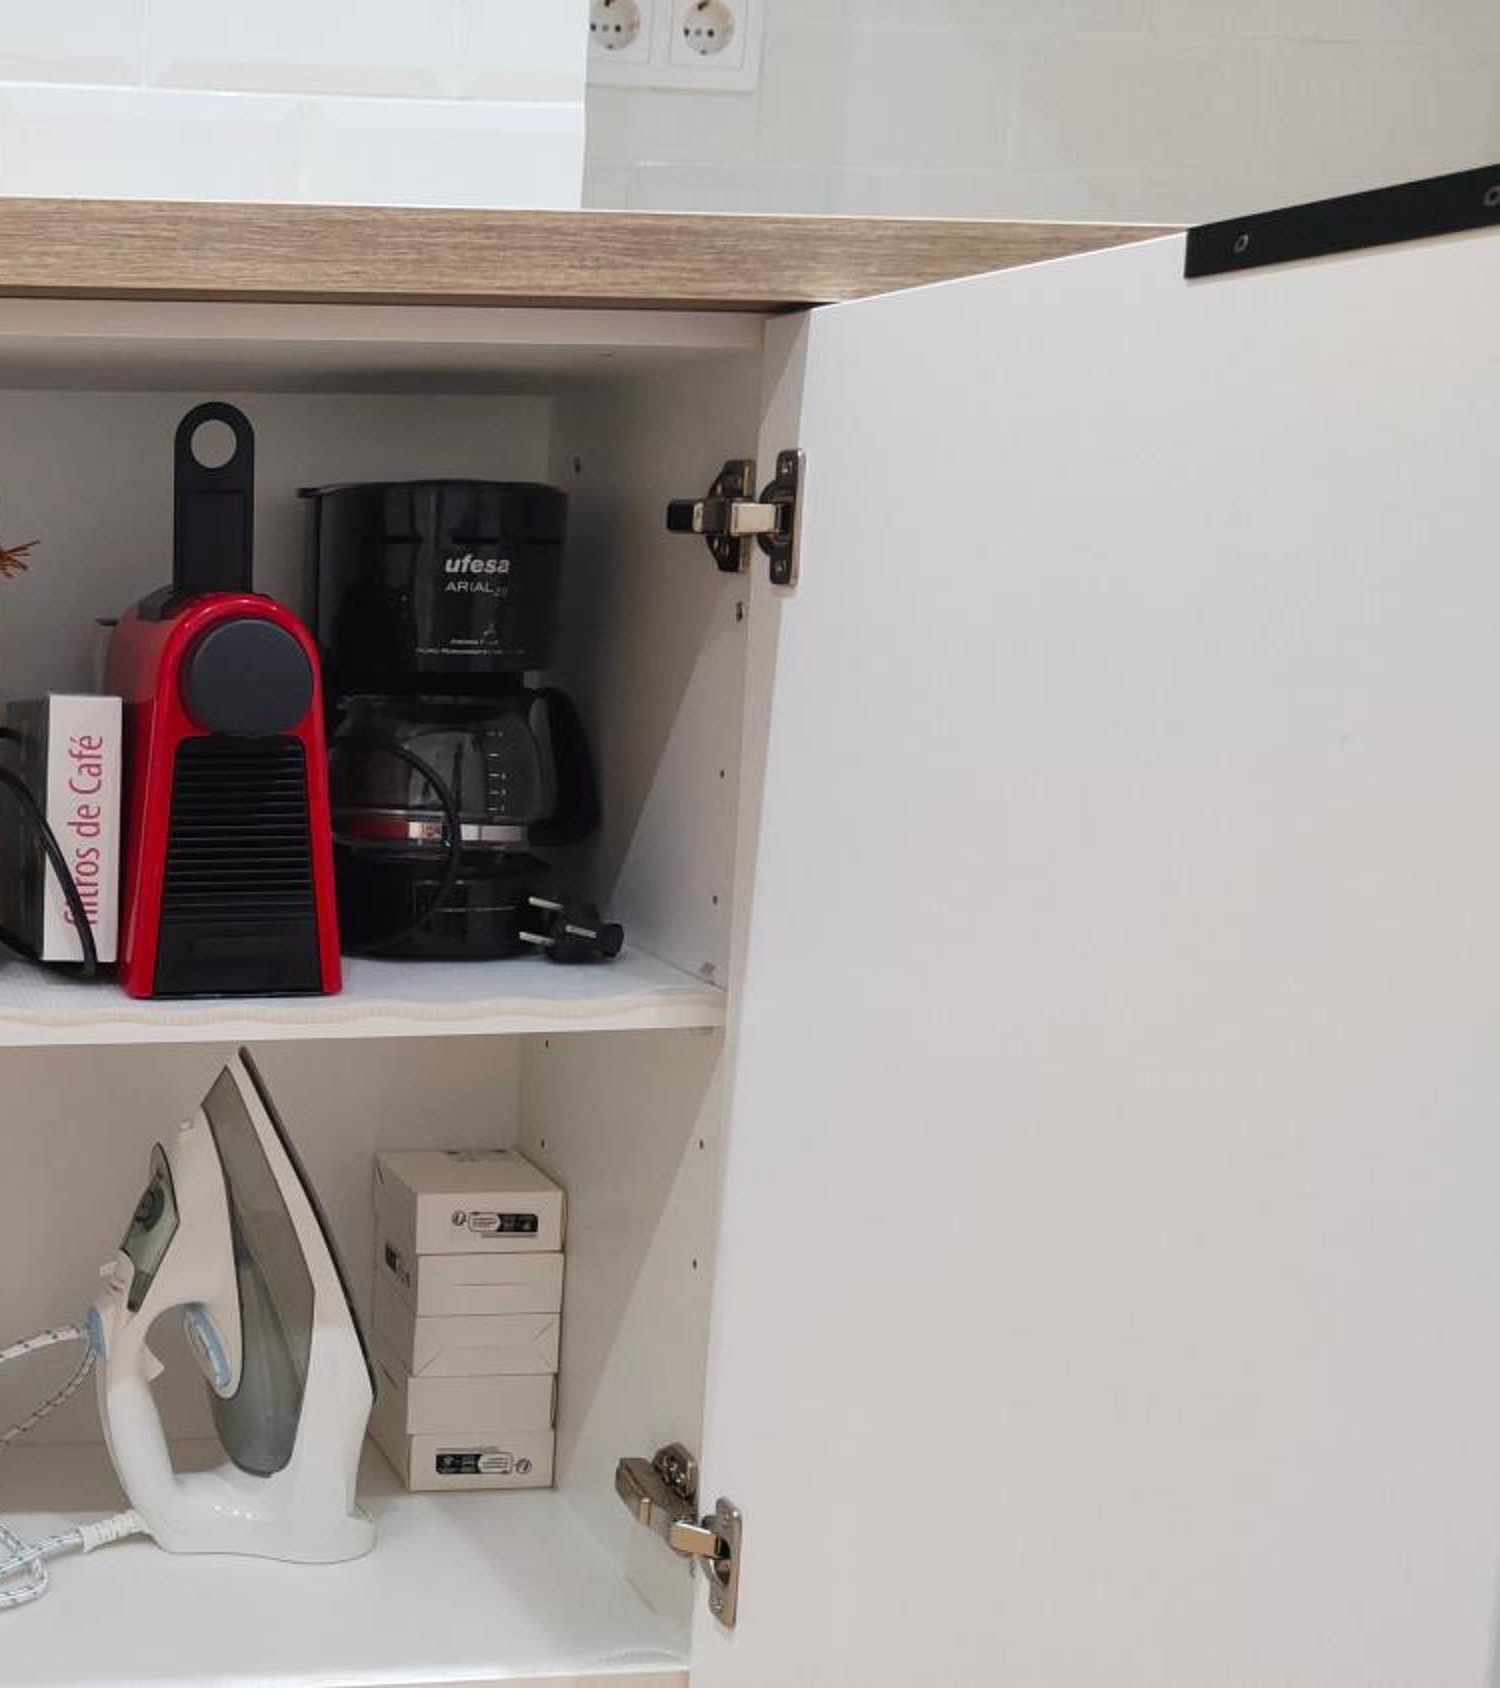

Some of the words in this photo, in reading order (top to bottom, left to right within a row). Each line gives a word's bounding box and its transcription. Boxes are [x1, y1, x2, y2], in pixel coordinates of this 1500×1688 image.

[445, 553, 511, 574] ufesa
[444, 581, 493, 593] ARIAL
[68, 735, 103, 795] Café
[68, 804, 101, 838] de
